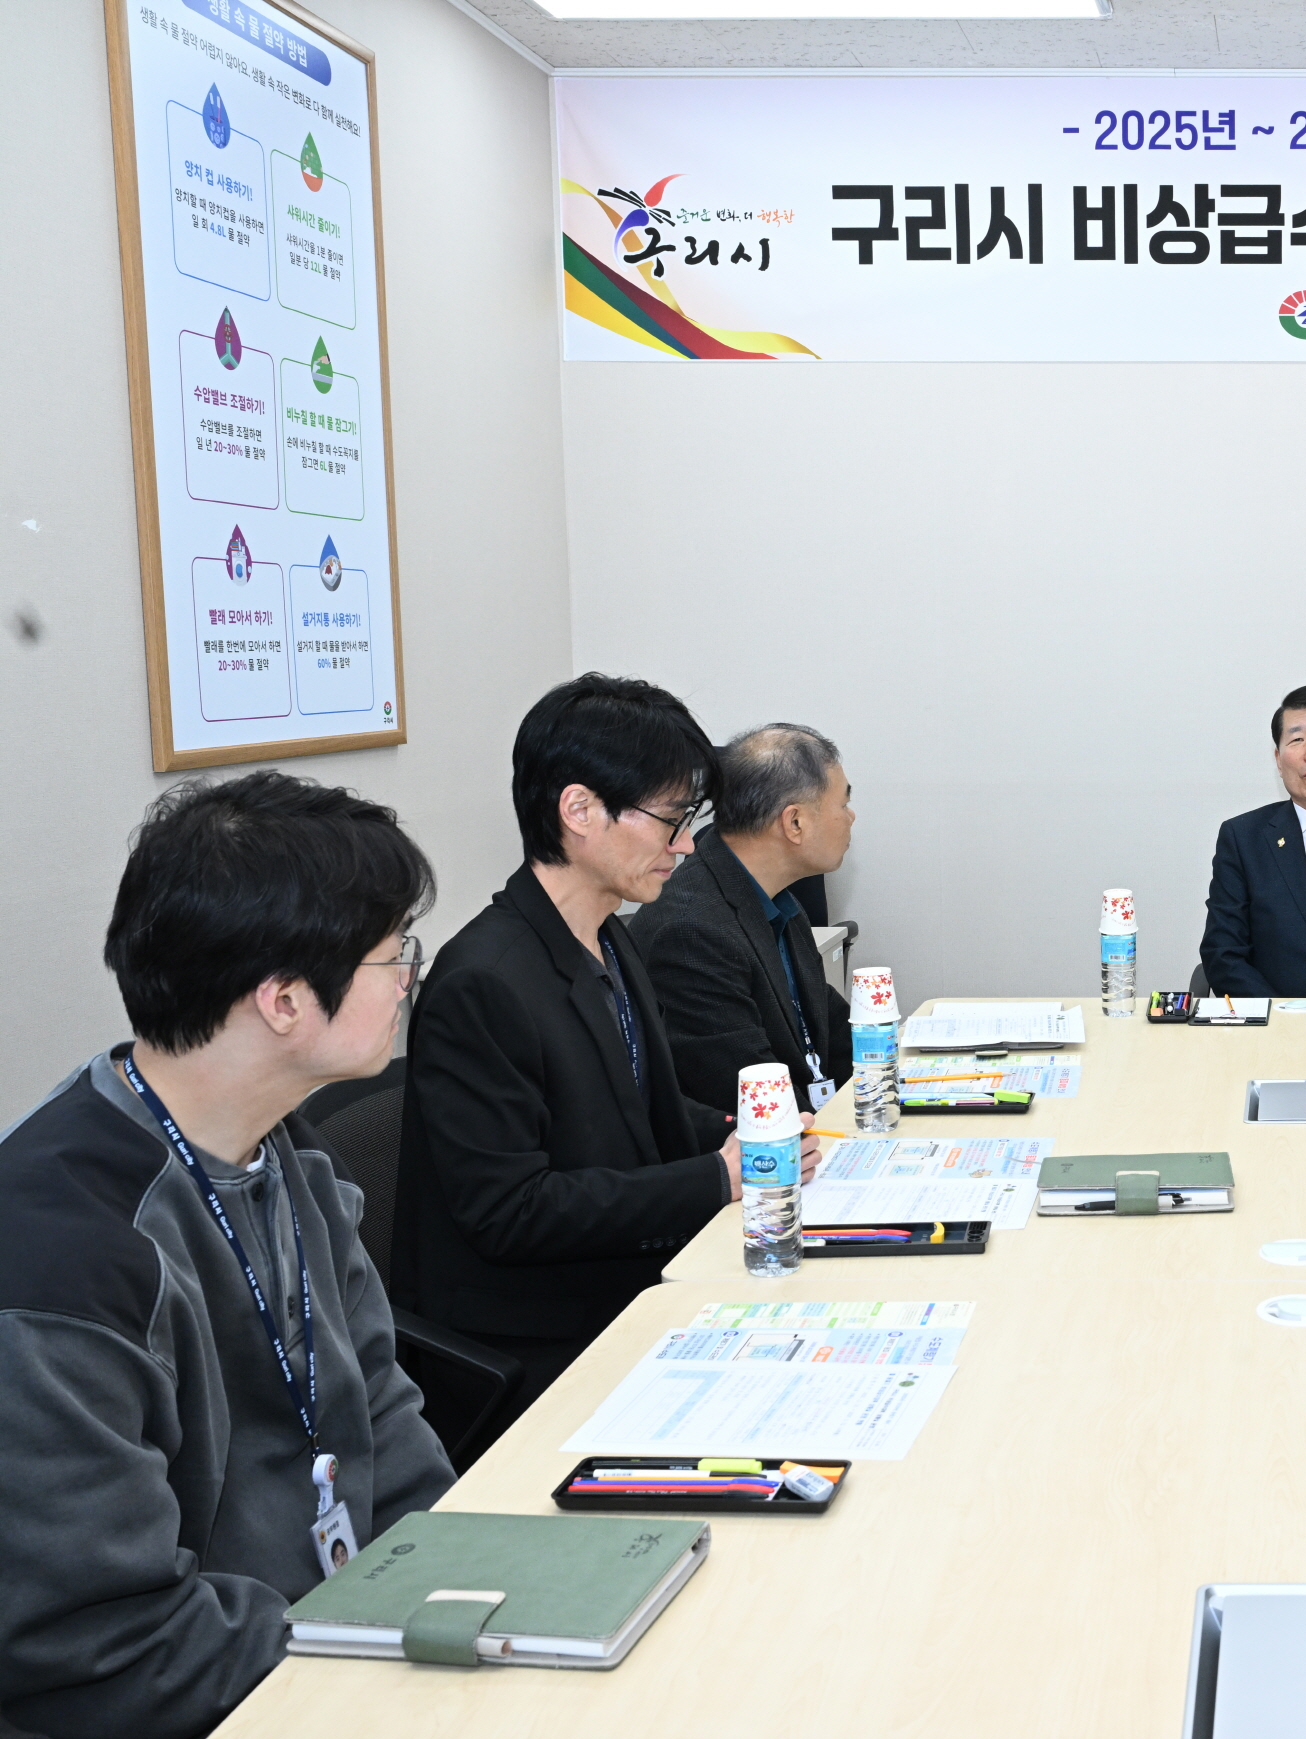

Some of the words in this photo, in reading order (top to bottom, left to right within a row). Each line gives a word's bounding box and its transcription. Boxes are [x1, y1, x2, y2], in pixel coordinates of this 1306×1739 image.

[234, 7, 245, 31] 속
[249, 14, 260, 40] 물
[263, 22, 284, 54] 절약
[287, 38, 308, 68] 방법
[140, 6, 157, 29] 생활
[160, 17, 169, 35] 속
[171, 22, 180, 41] 물
[181, 27, 198, 51] 절약
[199, 39, 224, 64] 어렵지
[252, 66, 266, 88] 생활
[268, 76, 275, 92] 속
[276, 80, 291, 100] 작은
[292, 89, 312, 111] 변화로
[313, 100, 320, 116] 다
[321, 104, 334, 124] 함께
[1094, 109, 1237, 151] 2025년
[185, 160, 202, 182] 양치
[205, 168, 214, 186] 컵
[217, 174, 253, 202] 사용하기!
[175, 188, 197, 208] 양치할
[199, 198, 207, 212] 때
[209, 201, 236, 223] 양치컵을
[239, 213, 265, 235] 사용하면
[287, 204, 315, 229] 샤워시간
[676, 207, 712, 224] 즐거운
[756, 208, 796, 228] 행복한
[192, 214, 199, 229] 일
[201, 218, 208, 232] 회
[210, 222, 227, 238] 4.8L
[228, 227, 235, 242] 물
[237, 231, 250, 248] 절약
[831, 183, 1043, 265] 구리시
[286, 233, 315, 255] 샤워시간을
[623, 227, 770, 278] 구리시
[310, 260, 322, 274] 12L
[322, 264, 329, 277] 물
[330, 266, 341, 282] 절약
[194, 385, 228, 406] 수압밸브
[230, 393, 265, 416] 조절하기!
[286, 406, 308, 426] 비누칠
[309, 411, 317, 427] 할
[318, 414, 325, 429] 때
[327, 415, 333, 431] 물
[200, 418, 234, 437] 수압밸브를
[236, 425, 262, 443] 조절하면
[196, 436, 203, 450] 일
[205, 438, 212, 452] 년
[213, 440, 243, 457] 20~30%
[244, 445, 251, 459] 물
[252, 446, 266, 461] 절약
[286, 435, 299, 449] 손에
[299, 438, 317, 453] 비누칠
[318, 442, 324, 455] 할
[325, 443, 331, 456] 때
[301, 456, 319, 471] 잠그면
[328, 461, 334, 474] 물
[335, 462, 346, 475] 절약
[208, 608, 226, 625] 빨래
[228, 609, 252, 626] 모아서
[254, 610, 273, 626] 하기!
[302, 611, 330, 627] 설거지통
[332, 612, 361, 628] 사용하기!
[203, 639, 224, 653] 빨래를
[226, 639, 246, 653] 한번에
[248, 640, 267, 653] 모아서
[268, 640, 281, 653] 하면
[297, 640, 314, 653] 설거지
[315, 640, 321, 653] 할
[329, 640, 340, 653] 물을
[341, 640, 357, 652] 받아서
[358, 640, 369, 652] 하면
[218, 659, 247, 671] 20~30%
[248, 658, 255, 671] 물
[256, 658, 270, 671] 절약
[317, 658, 331, 669] 60%
[332, 657, 338, 669] 물
[339, 657, 350, 669] 절약
[163, 1118, 181, 1141] 구리시
[754, 1160, 775, 1169] 백산수
[208, 1192, 223, 1215] 구리시
